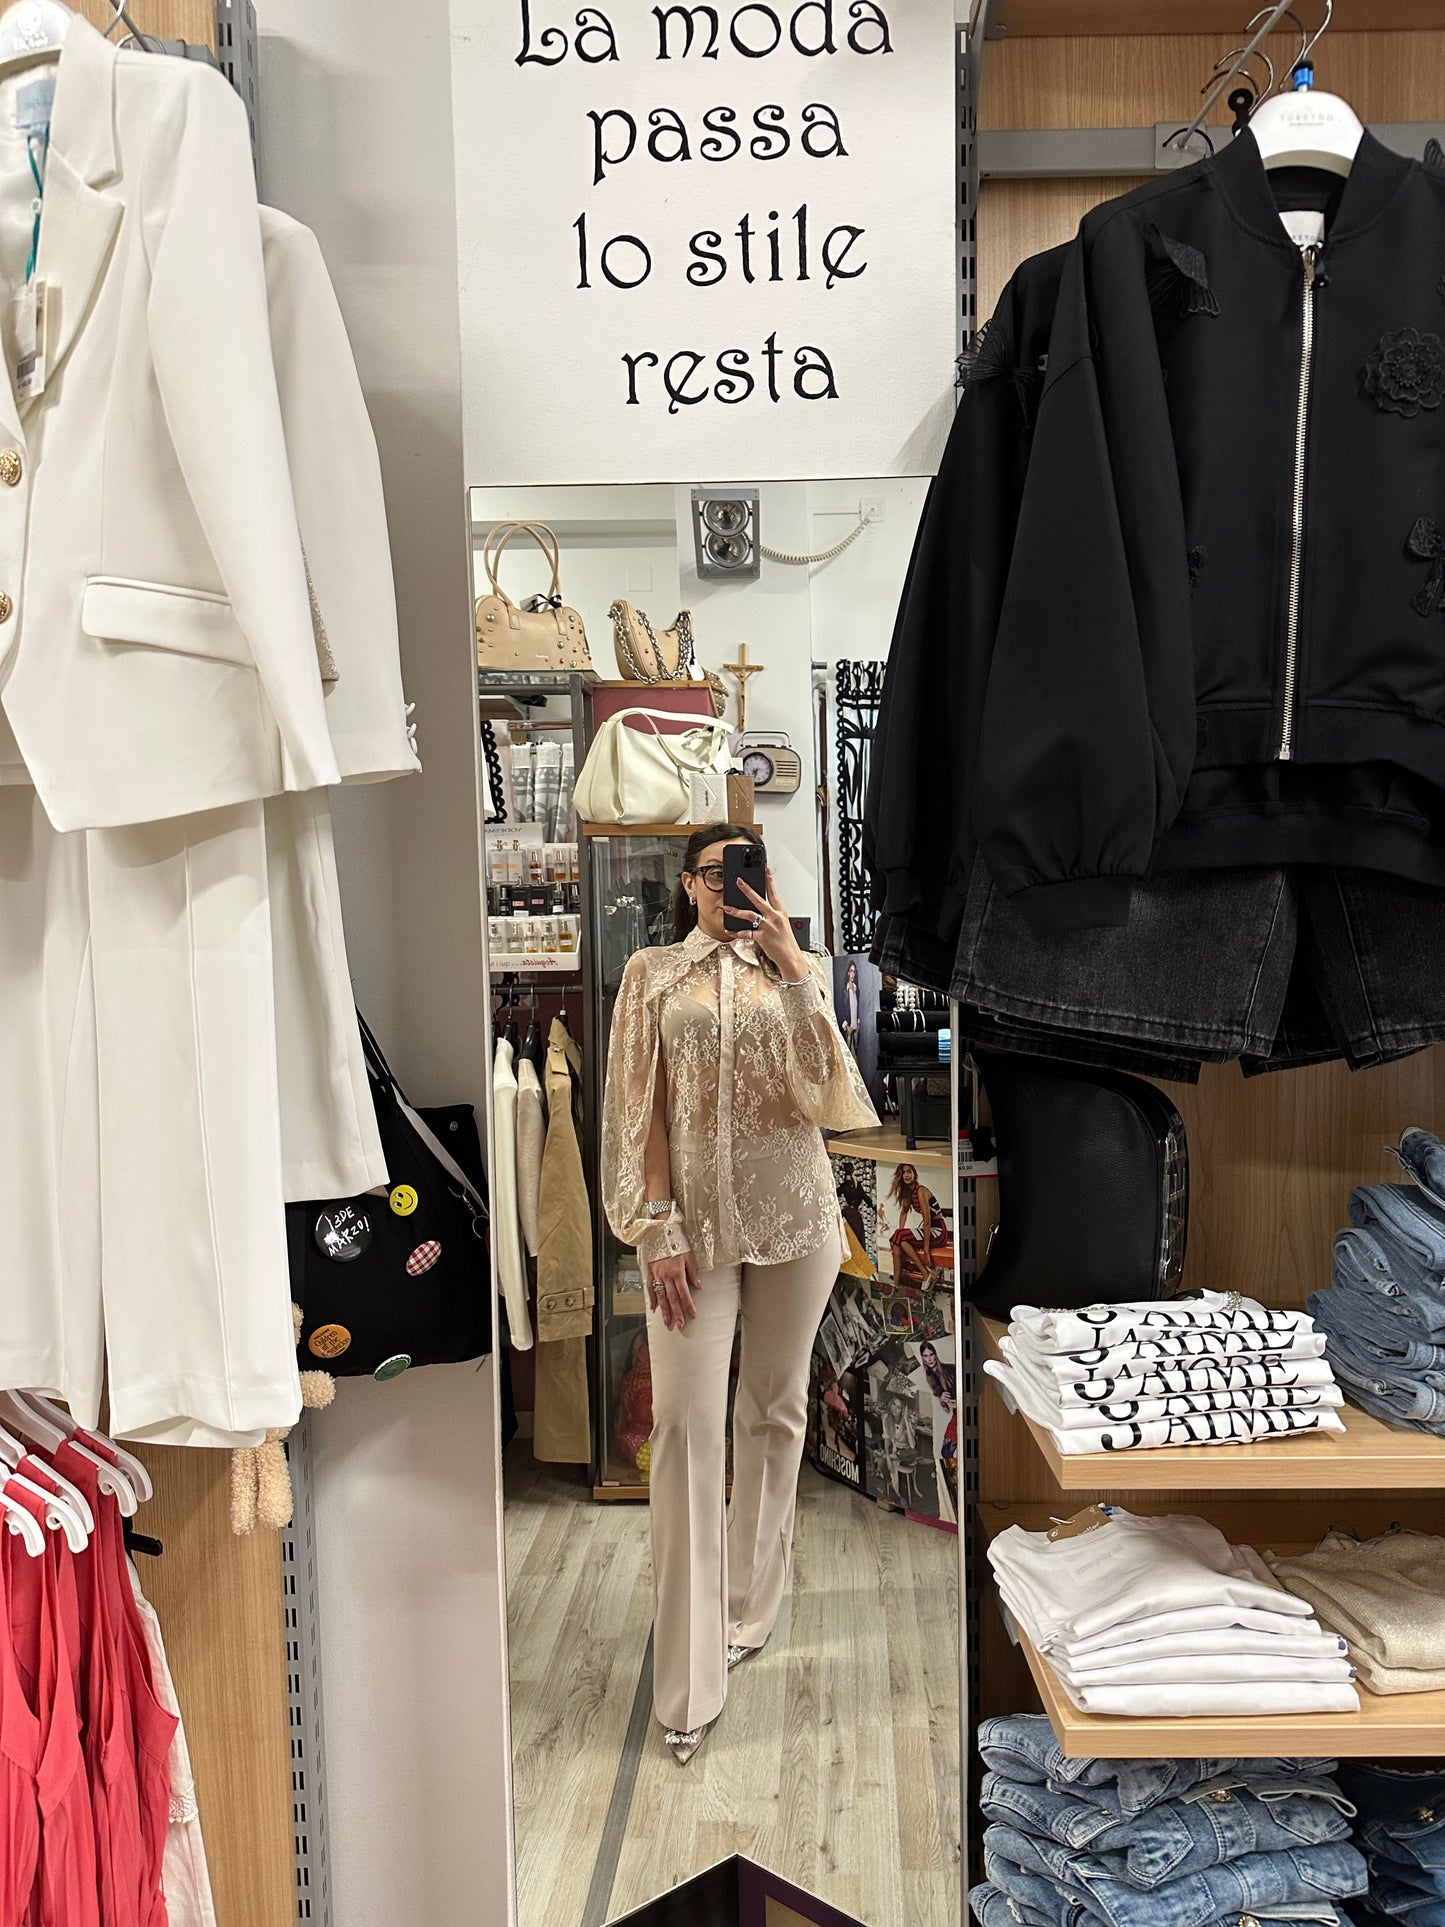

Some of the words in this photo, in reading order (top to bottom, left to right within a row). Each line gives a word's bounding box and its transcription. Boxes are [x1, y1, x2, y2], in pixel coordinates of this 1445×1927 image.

[514, 0, 620, 67] La
[652, 0, 894, 60] moda
[586, 103, 849, 186] passa
[572, 212, 652, 288] lo
[686, 203, 868, 289] stile
[621, 331, 840, 414] resta
